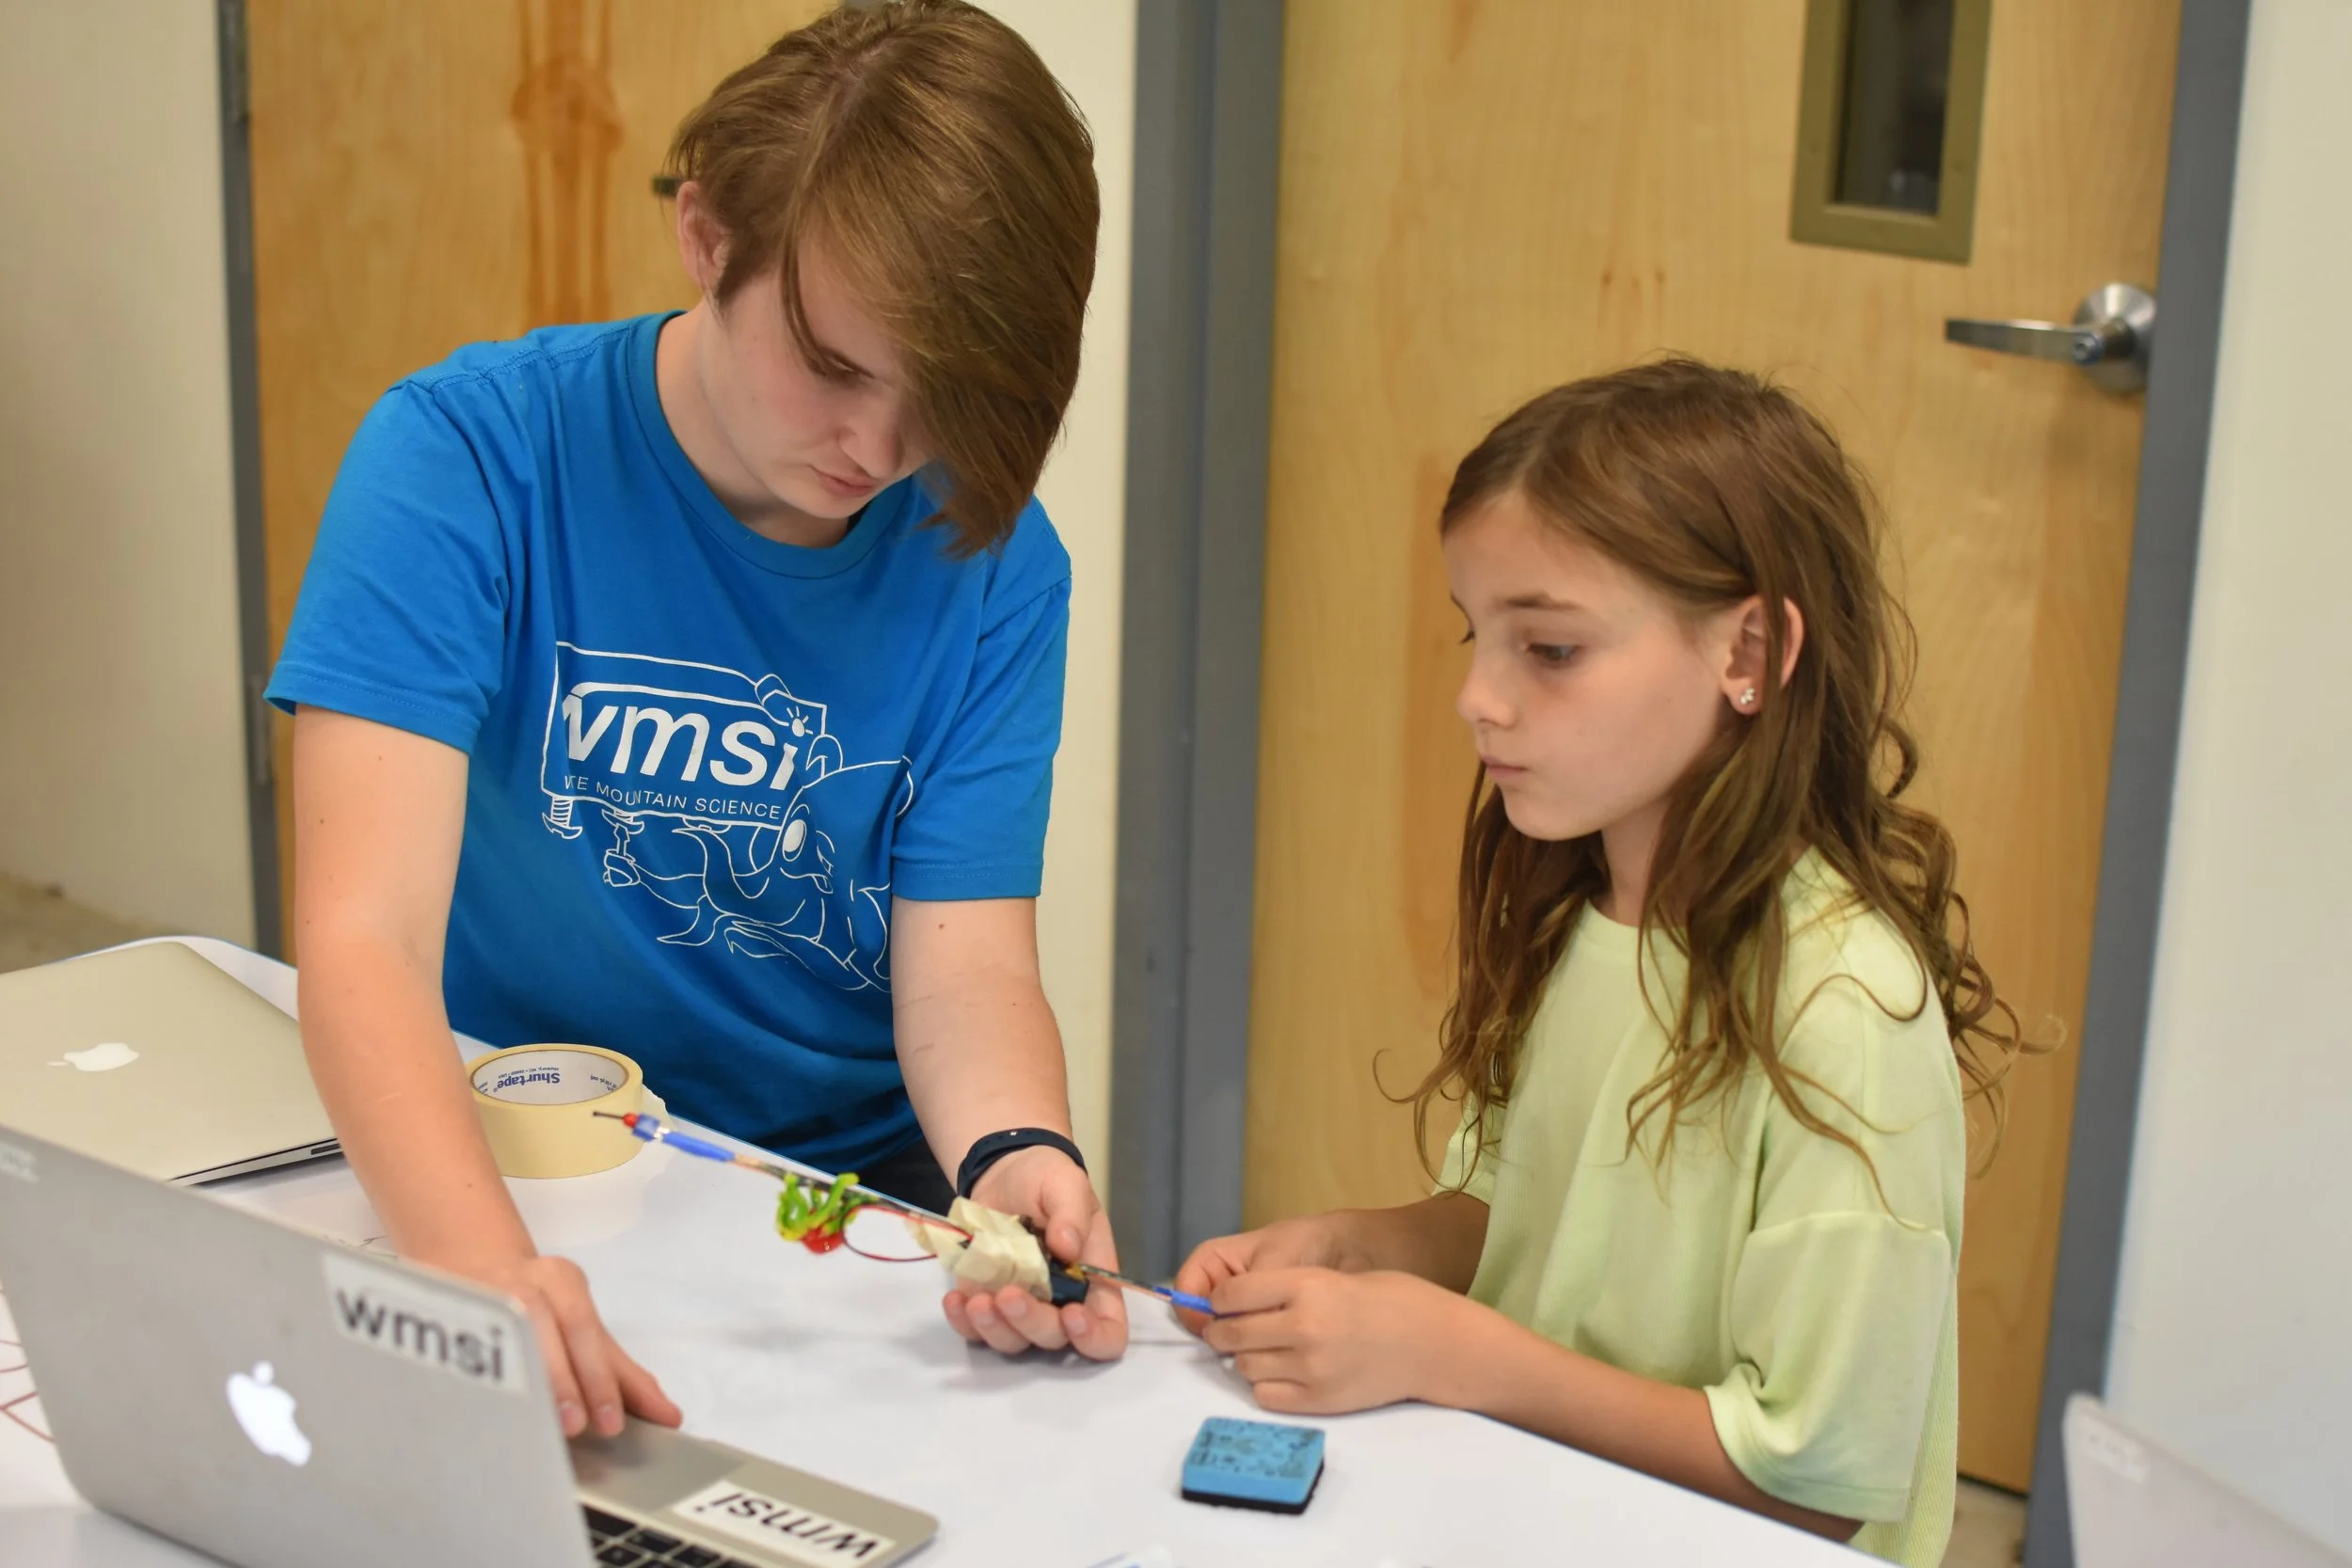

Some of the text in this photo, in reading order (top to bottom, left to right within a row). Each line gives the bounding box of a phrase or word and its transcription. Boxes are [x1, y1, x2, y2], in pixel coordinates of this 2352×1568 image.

[596, 782, 688, 810] MOUNTAIN
[694, 798, 782, 820] SCIENCE
[497, 1072, 561, 1089] Shurtape
[336, 1289, 504, 1381] wmsi
[694, 1492, 878, 1559] wmsi
